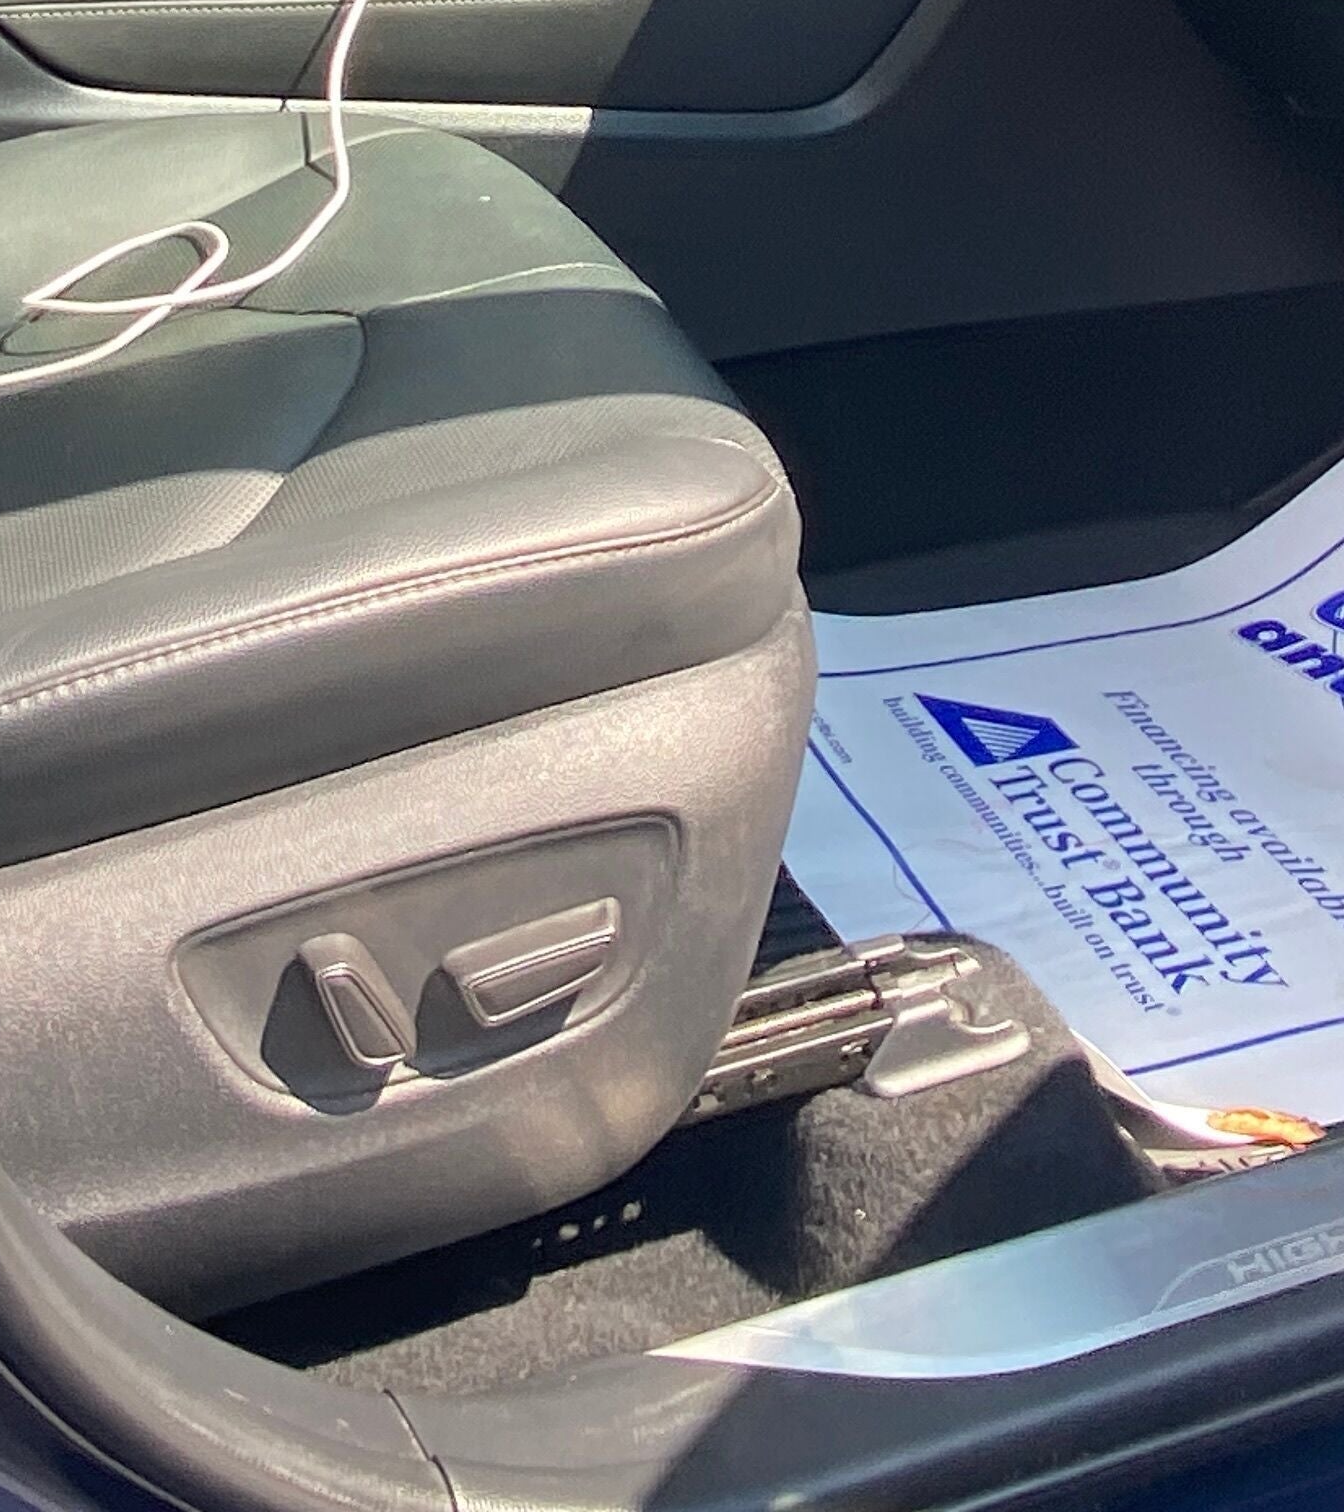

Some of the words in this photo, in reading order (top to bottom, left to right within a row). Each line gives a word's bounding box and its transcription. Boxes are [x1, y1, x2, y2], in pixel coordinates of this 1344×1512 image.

[1103, 690, 1237, 803] Financing
[882, 695, 946, 764] building
[1084, 932, 1115, 961] on
[1047, 756, 1290, 989] Community
[1131, 763, 1252, 863] through
[1080, 875, 1215, 995] Bank
